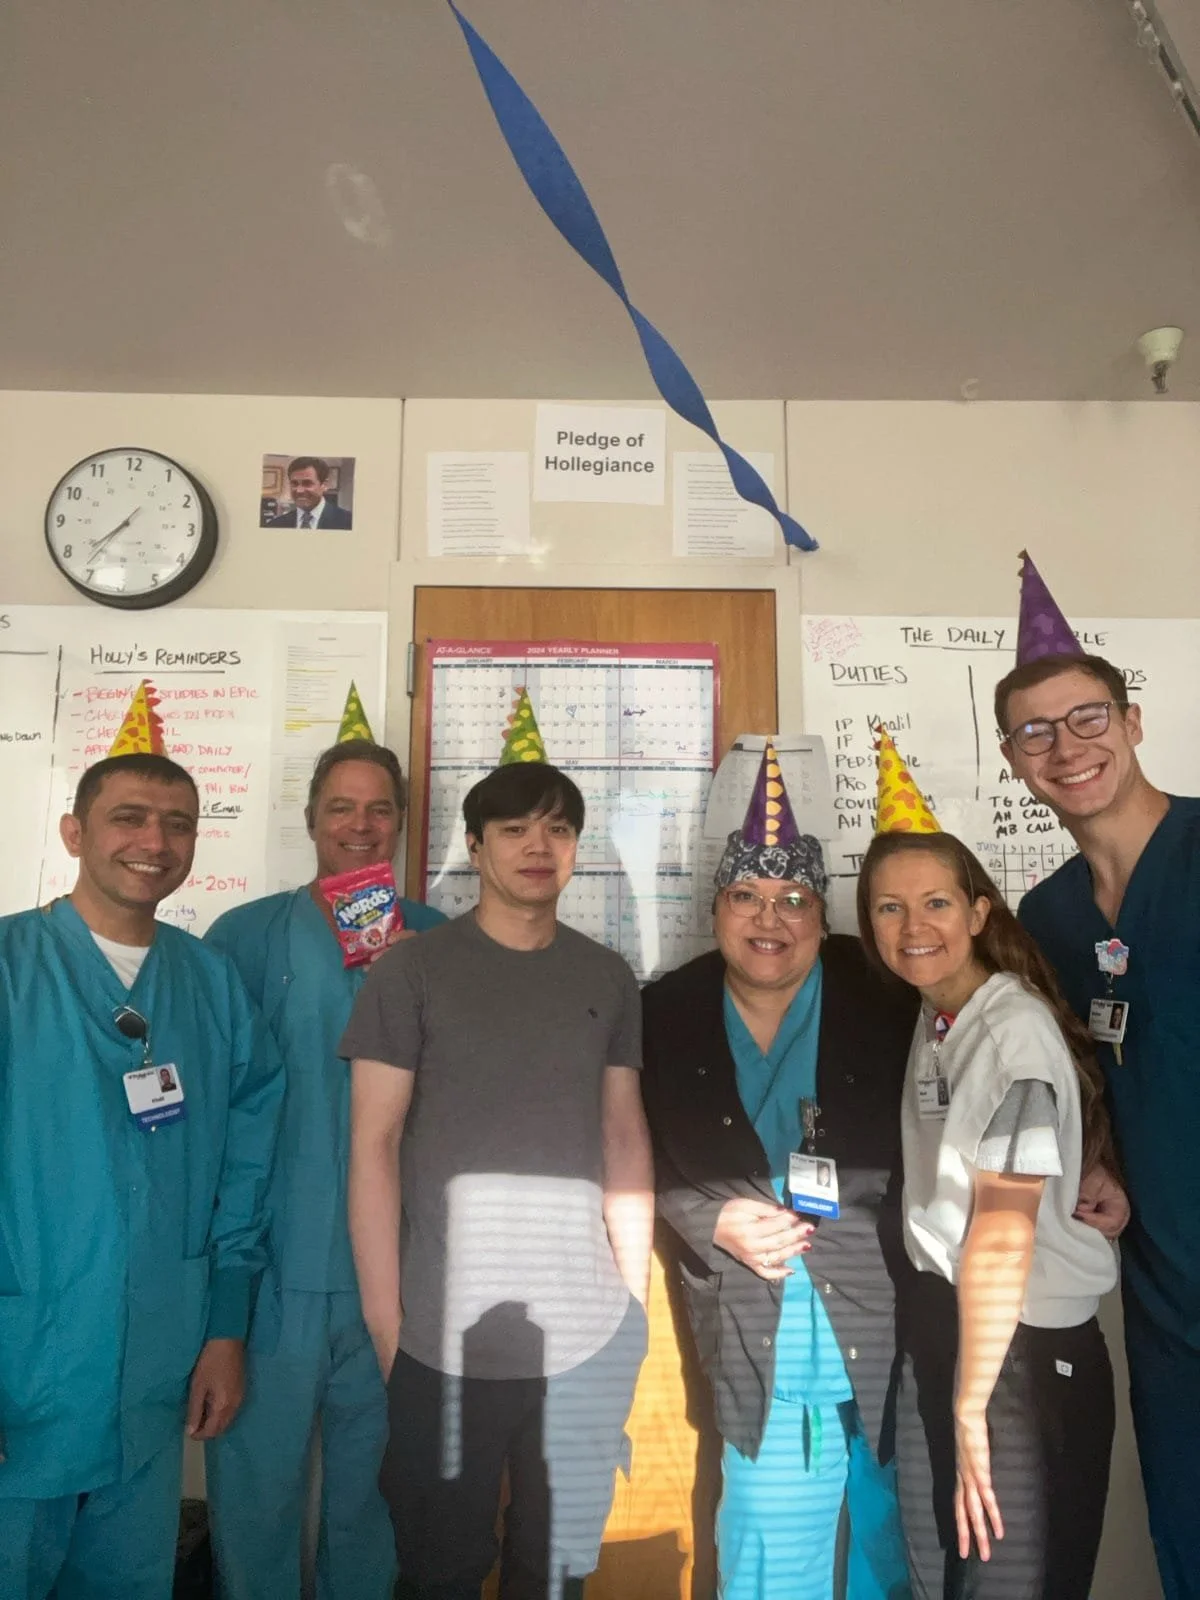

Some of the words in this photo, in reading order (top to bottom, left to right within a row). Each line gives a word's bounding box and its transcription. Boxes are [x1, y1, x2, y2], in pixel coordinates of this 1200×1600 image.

[557, 431, 620, 450] Pledge
[626, 433, 645, 447] of
[91, 463, 105, 478] 11
[126, 457, 142, 471] 12
[545, 456, 655, 476] Hollegiance
[165, 469, 172, 483] 1
[66, 487, 82, 500] 10
[182, 494, 191, 508] 2
[56, 514, 65, 528] 9
[186, 523, 195, 537] 3
[63, 544, 72, 558] 8
[176, 552, 185, 567] 4
[85, 568, 95, 583] 7
[151, 573, 159, 587] 5
[900, 627, 933, 644] THE
[948, 628, 1005, 648] DAILY
[155, 649, 241, 666] REMINDERS
[829, 663, 908, 684] DUTIES
[159, 688, 209, 700] STUDIES
[212, 688, 225, 698] IN
[230, 686, 260, 699] EPIC
[835, 718, 853, 731] IP
[836, 734, 853, 749] IP
[197, 744, 233, 756] DAILY
[835, 774, 867, 792] PRO
[1022, 808, 1051, 820] CALL
[838, 814, 862, 829] AH
[1026, 822, 1055, 833] CALL
